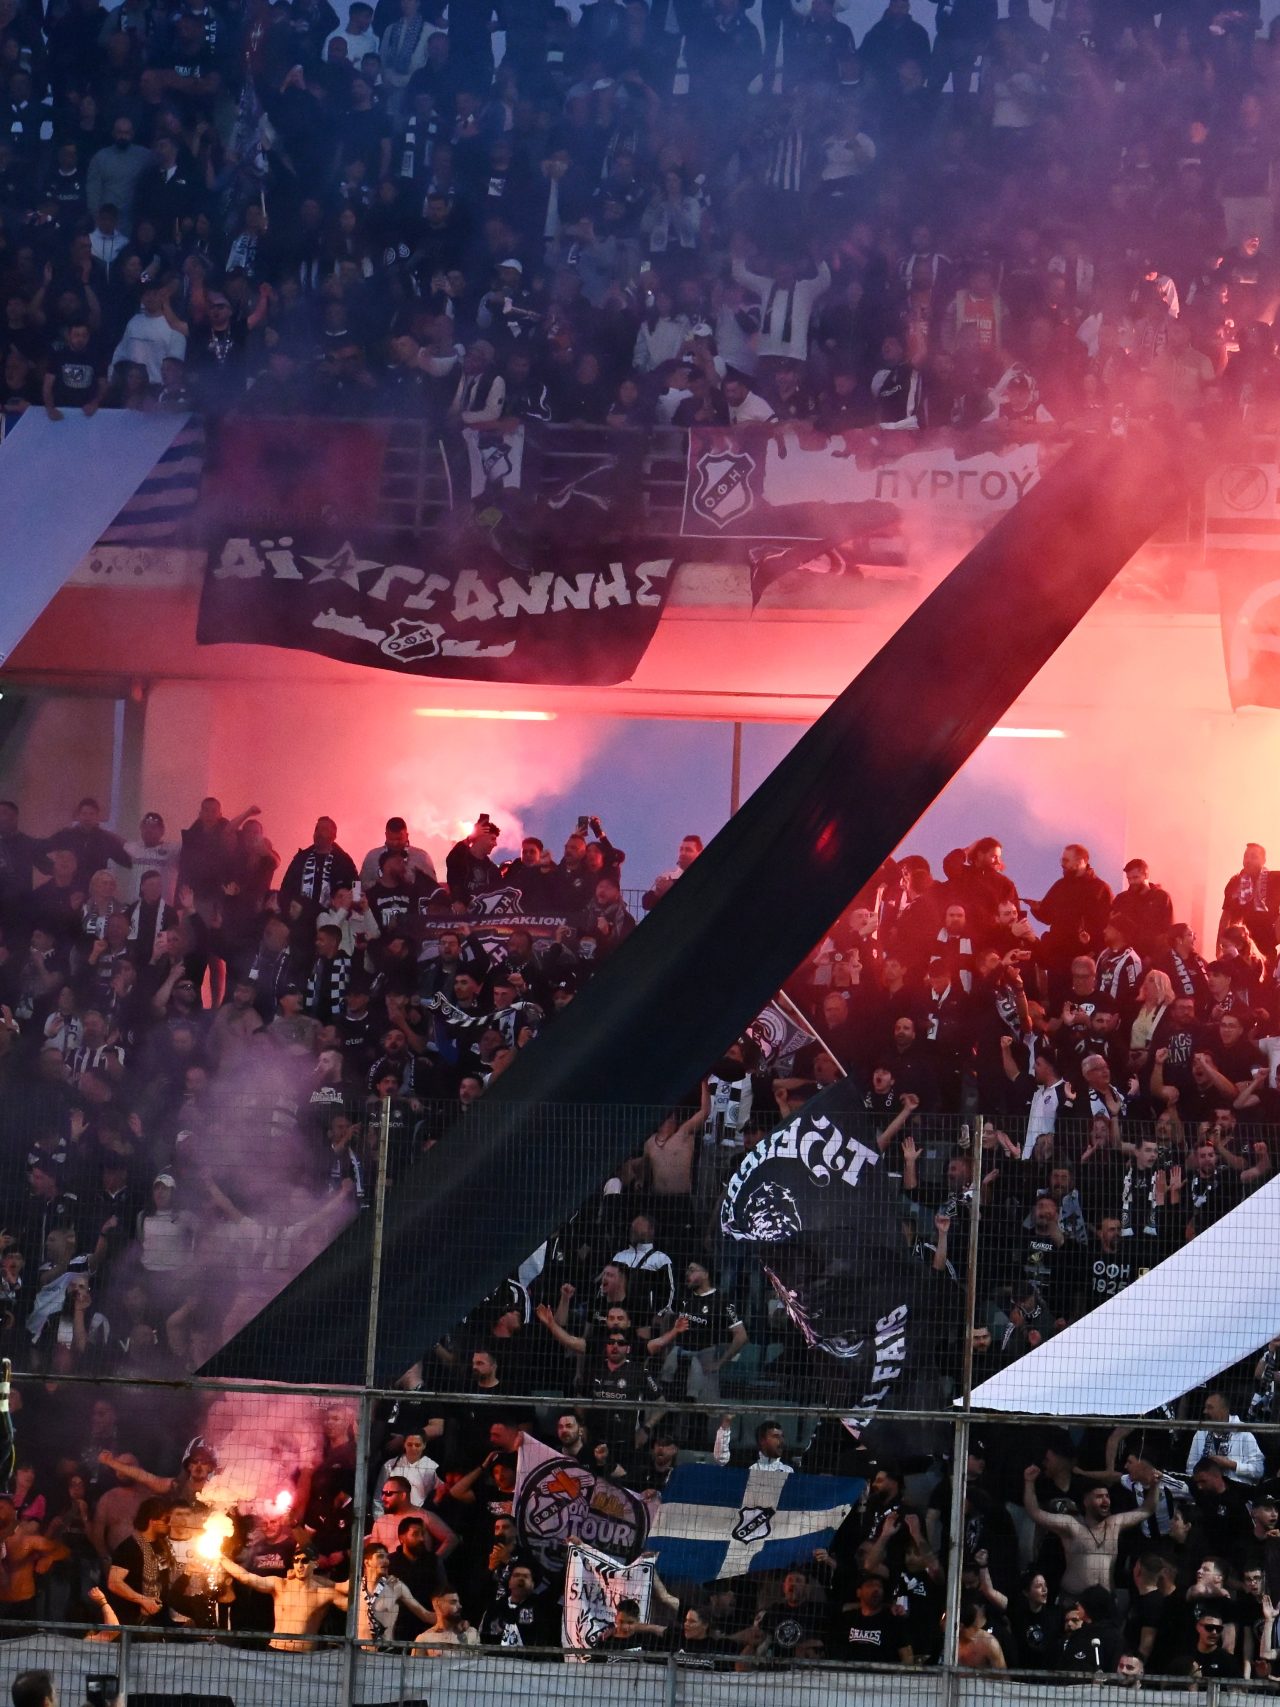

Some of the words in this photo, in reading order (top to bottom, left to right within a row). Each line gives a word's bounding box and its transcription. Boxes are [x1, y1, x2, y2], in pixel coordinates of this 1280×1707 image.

[873, 469, 1034, 501] ΠΥΡΓΟΥ
[366, 558, 675, 623] ΓΙΑΝΝΗΣ
[1092, 1260, 1131, 1279] ΟΦΗ
[569, 1503, 590, 1517] ON
[849, 1627, 882, 1643] SNAKES
